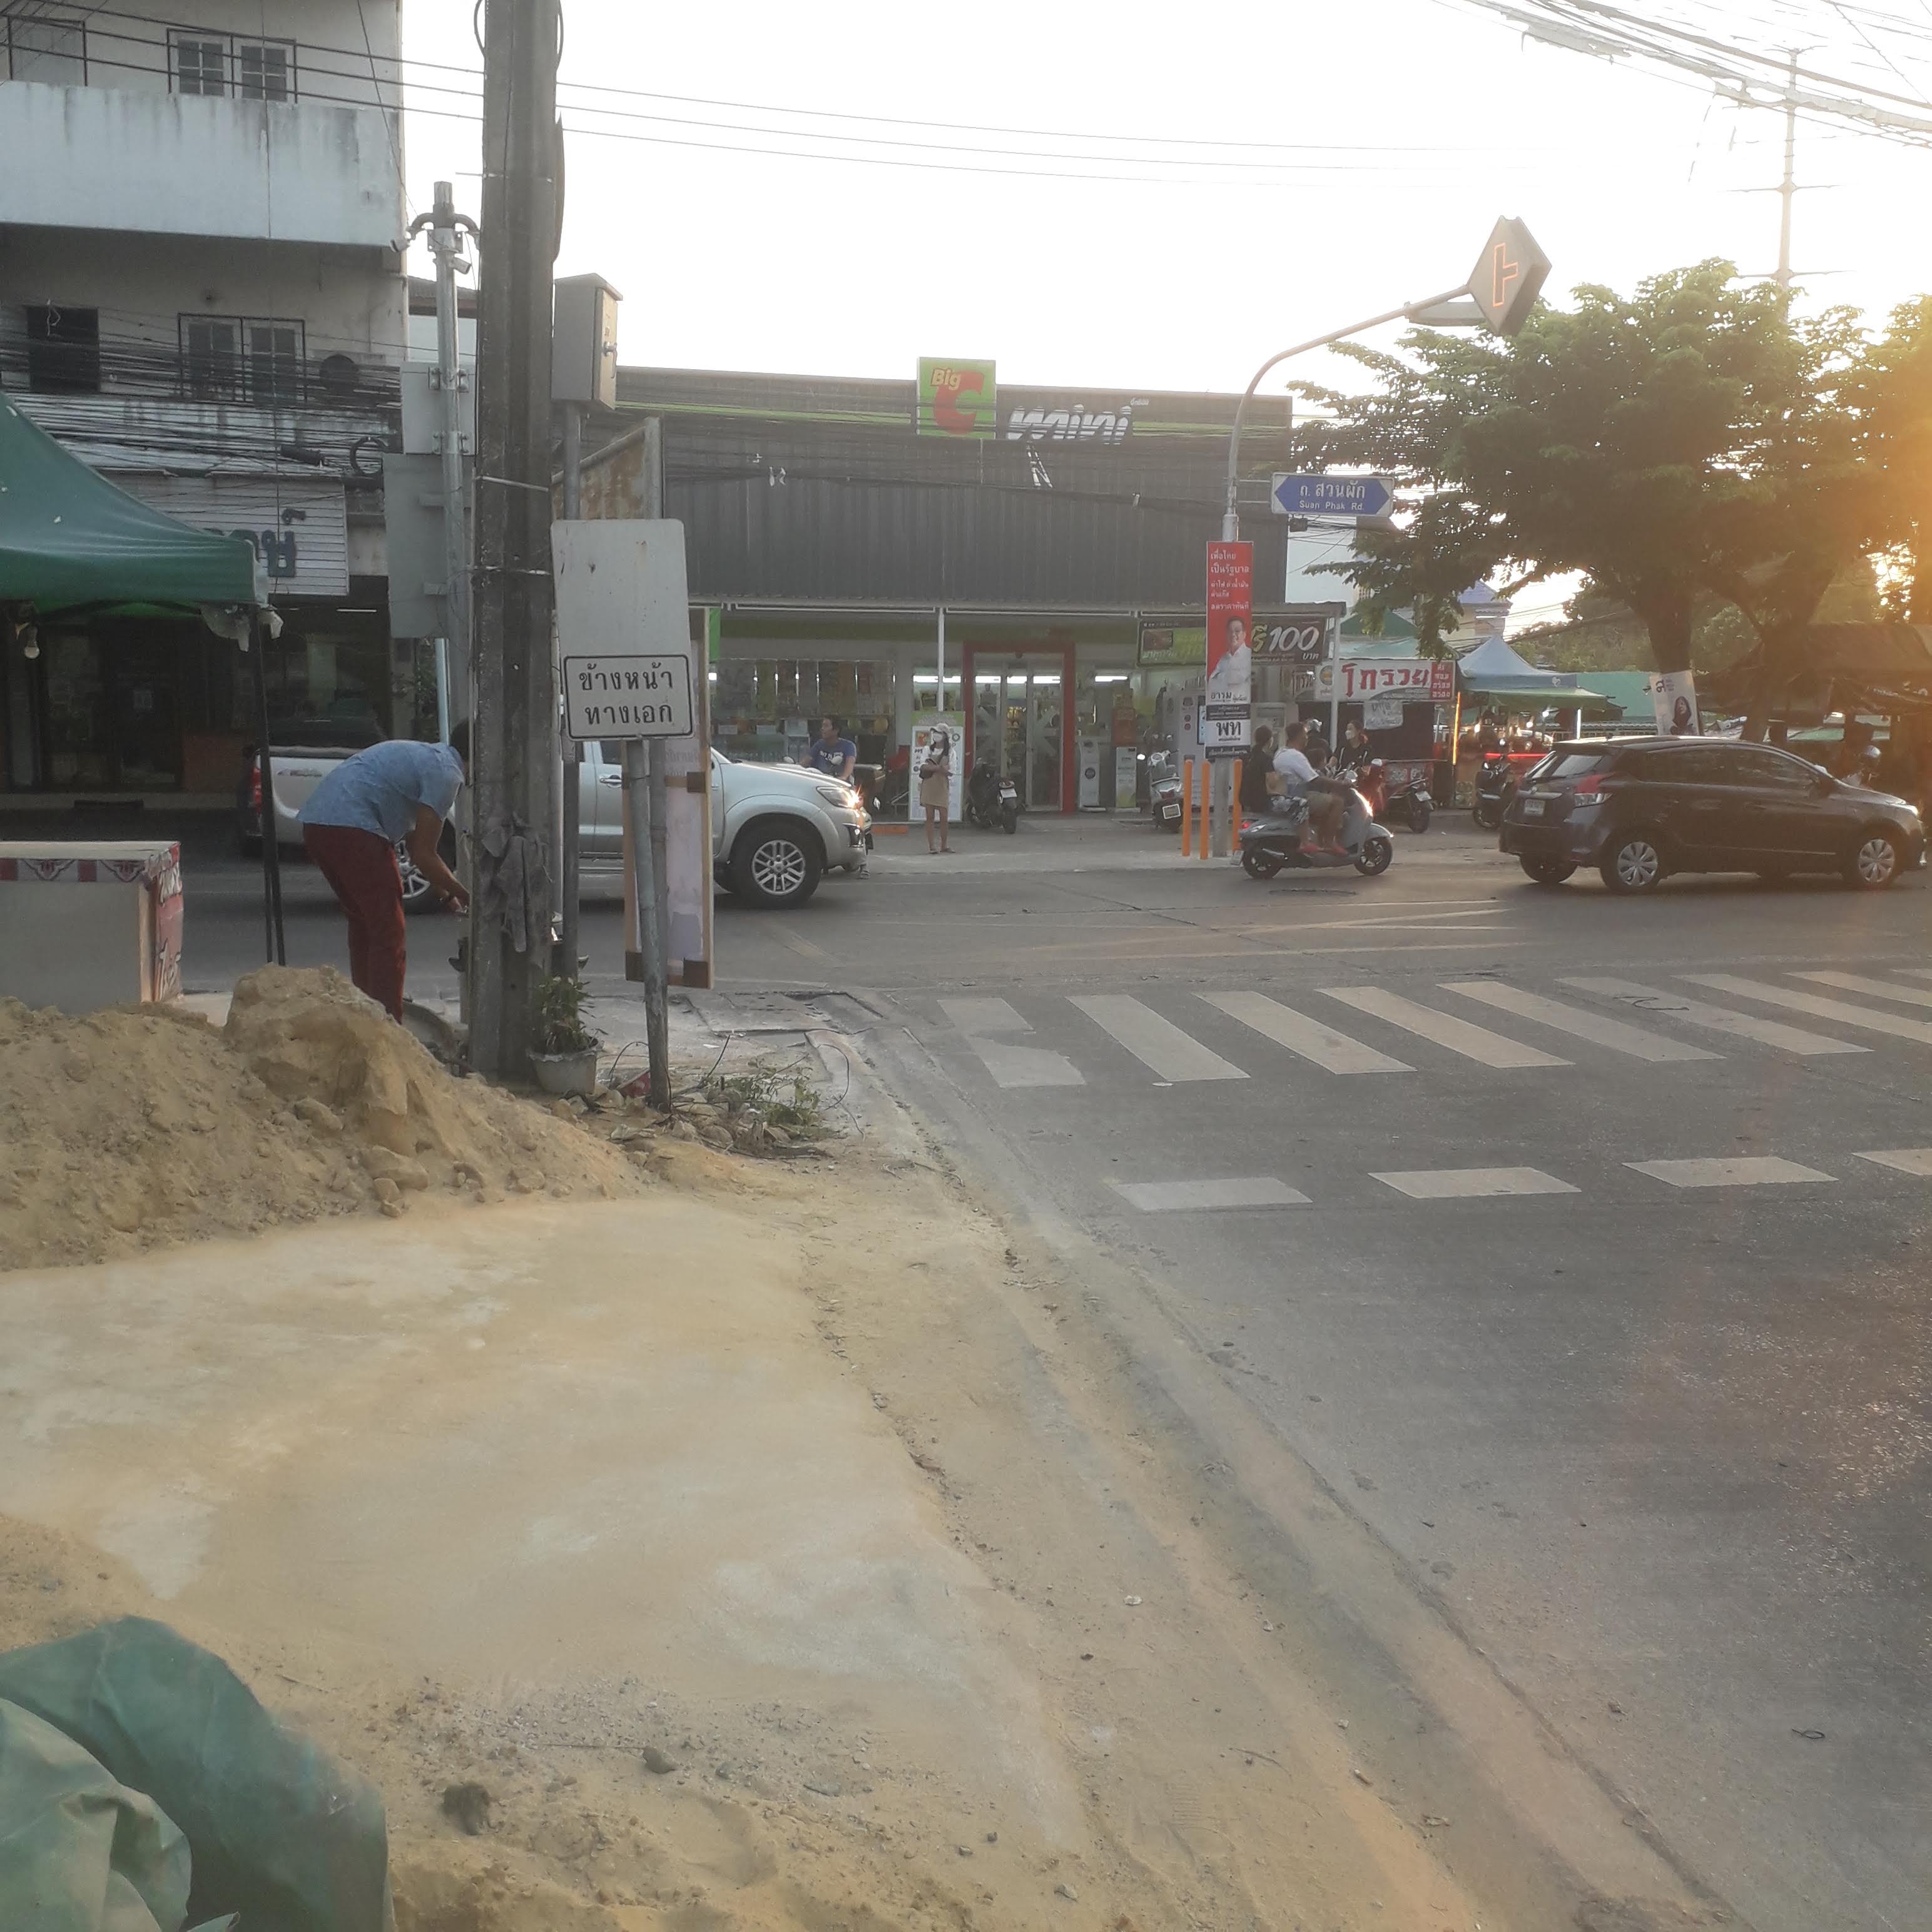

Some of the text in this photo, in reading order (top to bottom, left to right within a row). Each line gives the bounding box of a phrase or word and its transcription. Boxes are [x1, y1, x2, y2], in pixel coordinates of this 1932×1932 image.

[930, 367, 962, 390] Big
[933, 370, 985, 436] C
[1006, 404, 1130, 445] mini
[1316, 480, 1365, 499] สวนผัก
[1299, 501, 1319, 509] Suan
[1326, 502, 1345, 511] Phak
[1211, 549, 1236, 560] เพื่อไทย
[1211, 562, 1249, 576] เป็นรัฐบาล
[1269, 626, 1319, 652] 100
[579, 661, 673, 691] ข้างหน้า
[584, 704, 673, 725] ทางเอก
[1216, 721, 1241, 736] พท
